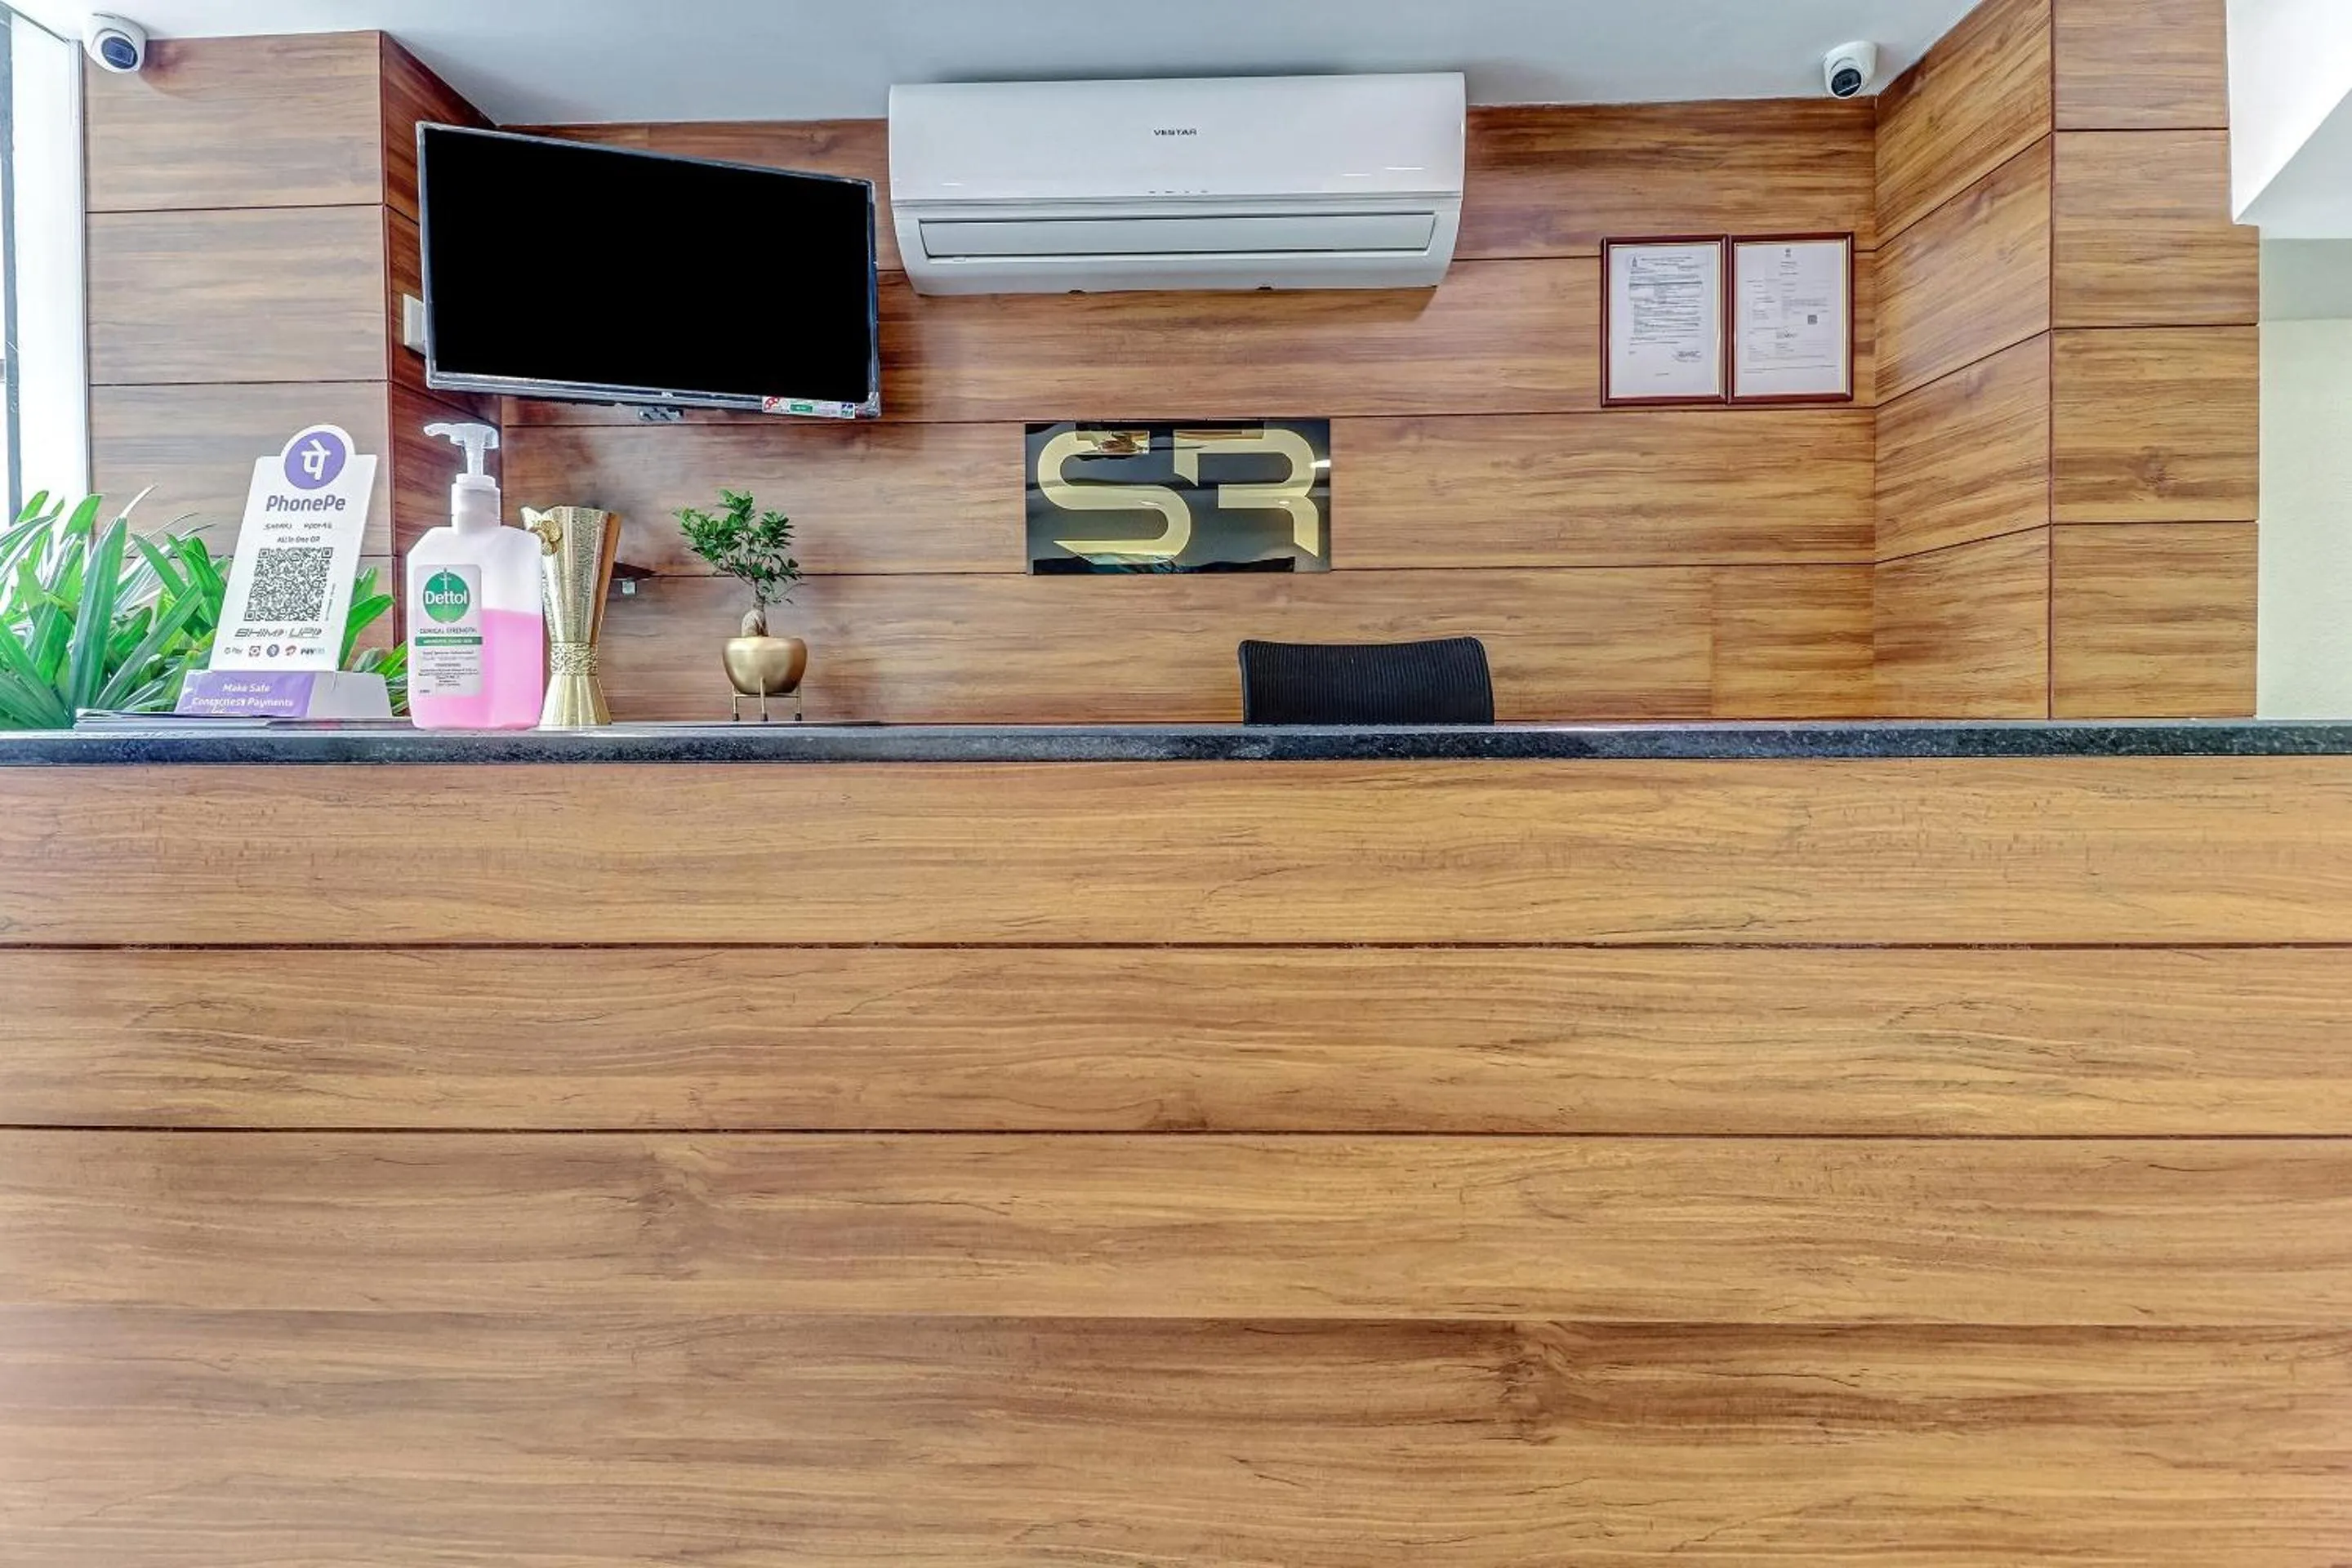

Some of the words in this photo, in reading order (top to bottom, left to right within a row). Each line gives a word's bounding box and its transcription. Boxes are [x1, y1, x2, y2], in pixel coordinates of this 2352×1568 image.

[265, 494, 346, 512] PhonePe
[425, 590, 467, 604] Dettol
[222, 684, 247, 693] Make
[249, 683, 270, 693] Safe
[247, 697, 294, 709] Payments
